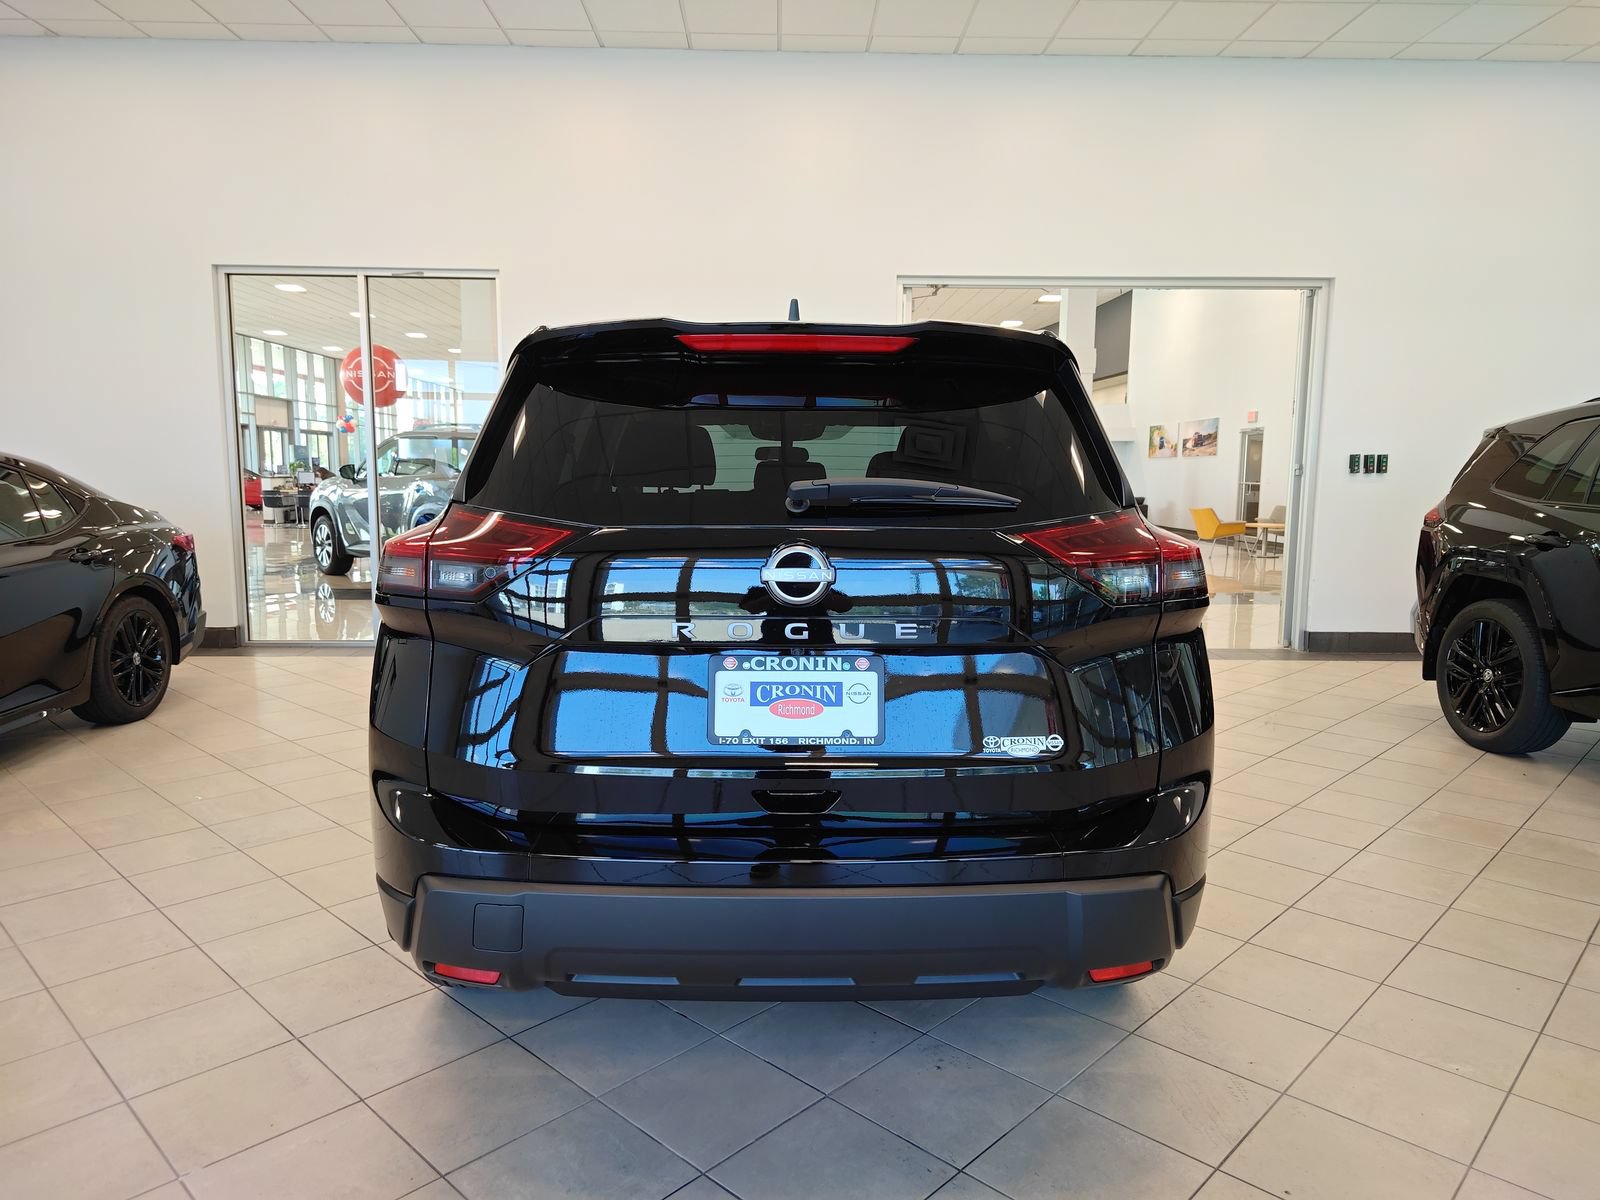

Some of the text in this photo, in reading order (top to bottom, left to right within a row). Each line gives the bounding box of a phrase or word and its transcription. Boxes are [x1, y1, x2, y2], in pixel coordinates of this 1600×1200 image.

[346, 370, 395, 378] NISAN
[764, 571, 832, 580] NISSAN
[672, 622, 918, 640] ROGUE
[750, 657, 843, 671] CRONIN
[756, 684, 837, 703] CRONIN
[777, 704, 816, 715] Richmond
[1002, 738, 1044, 747] CRONIN
